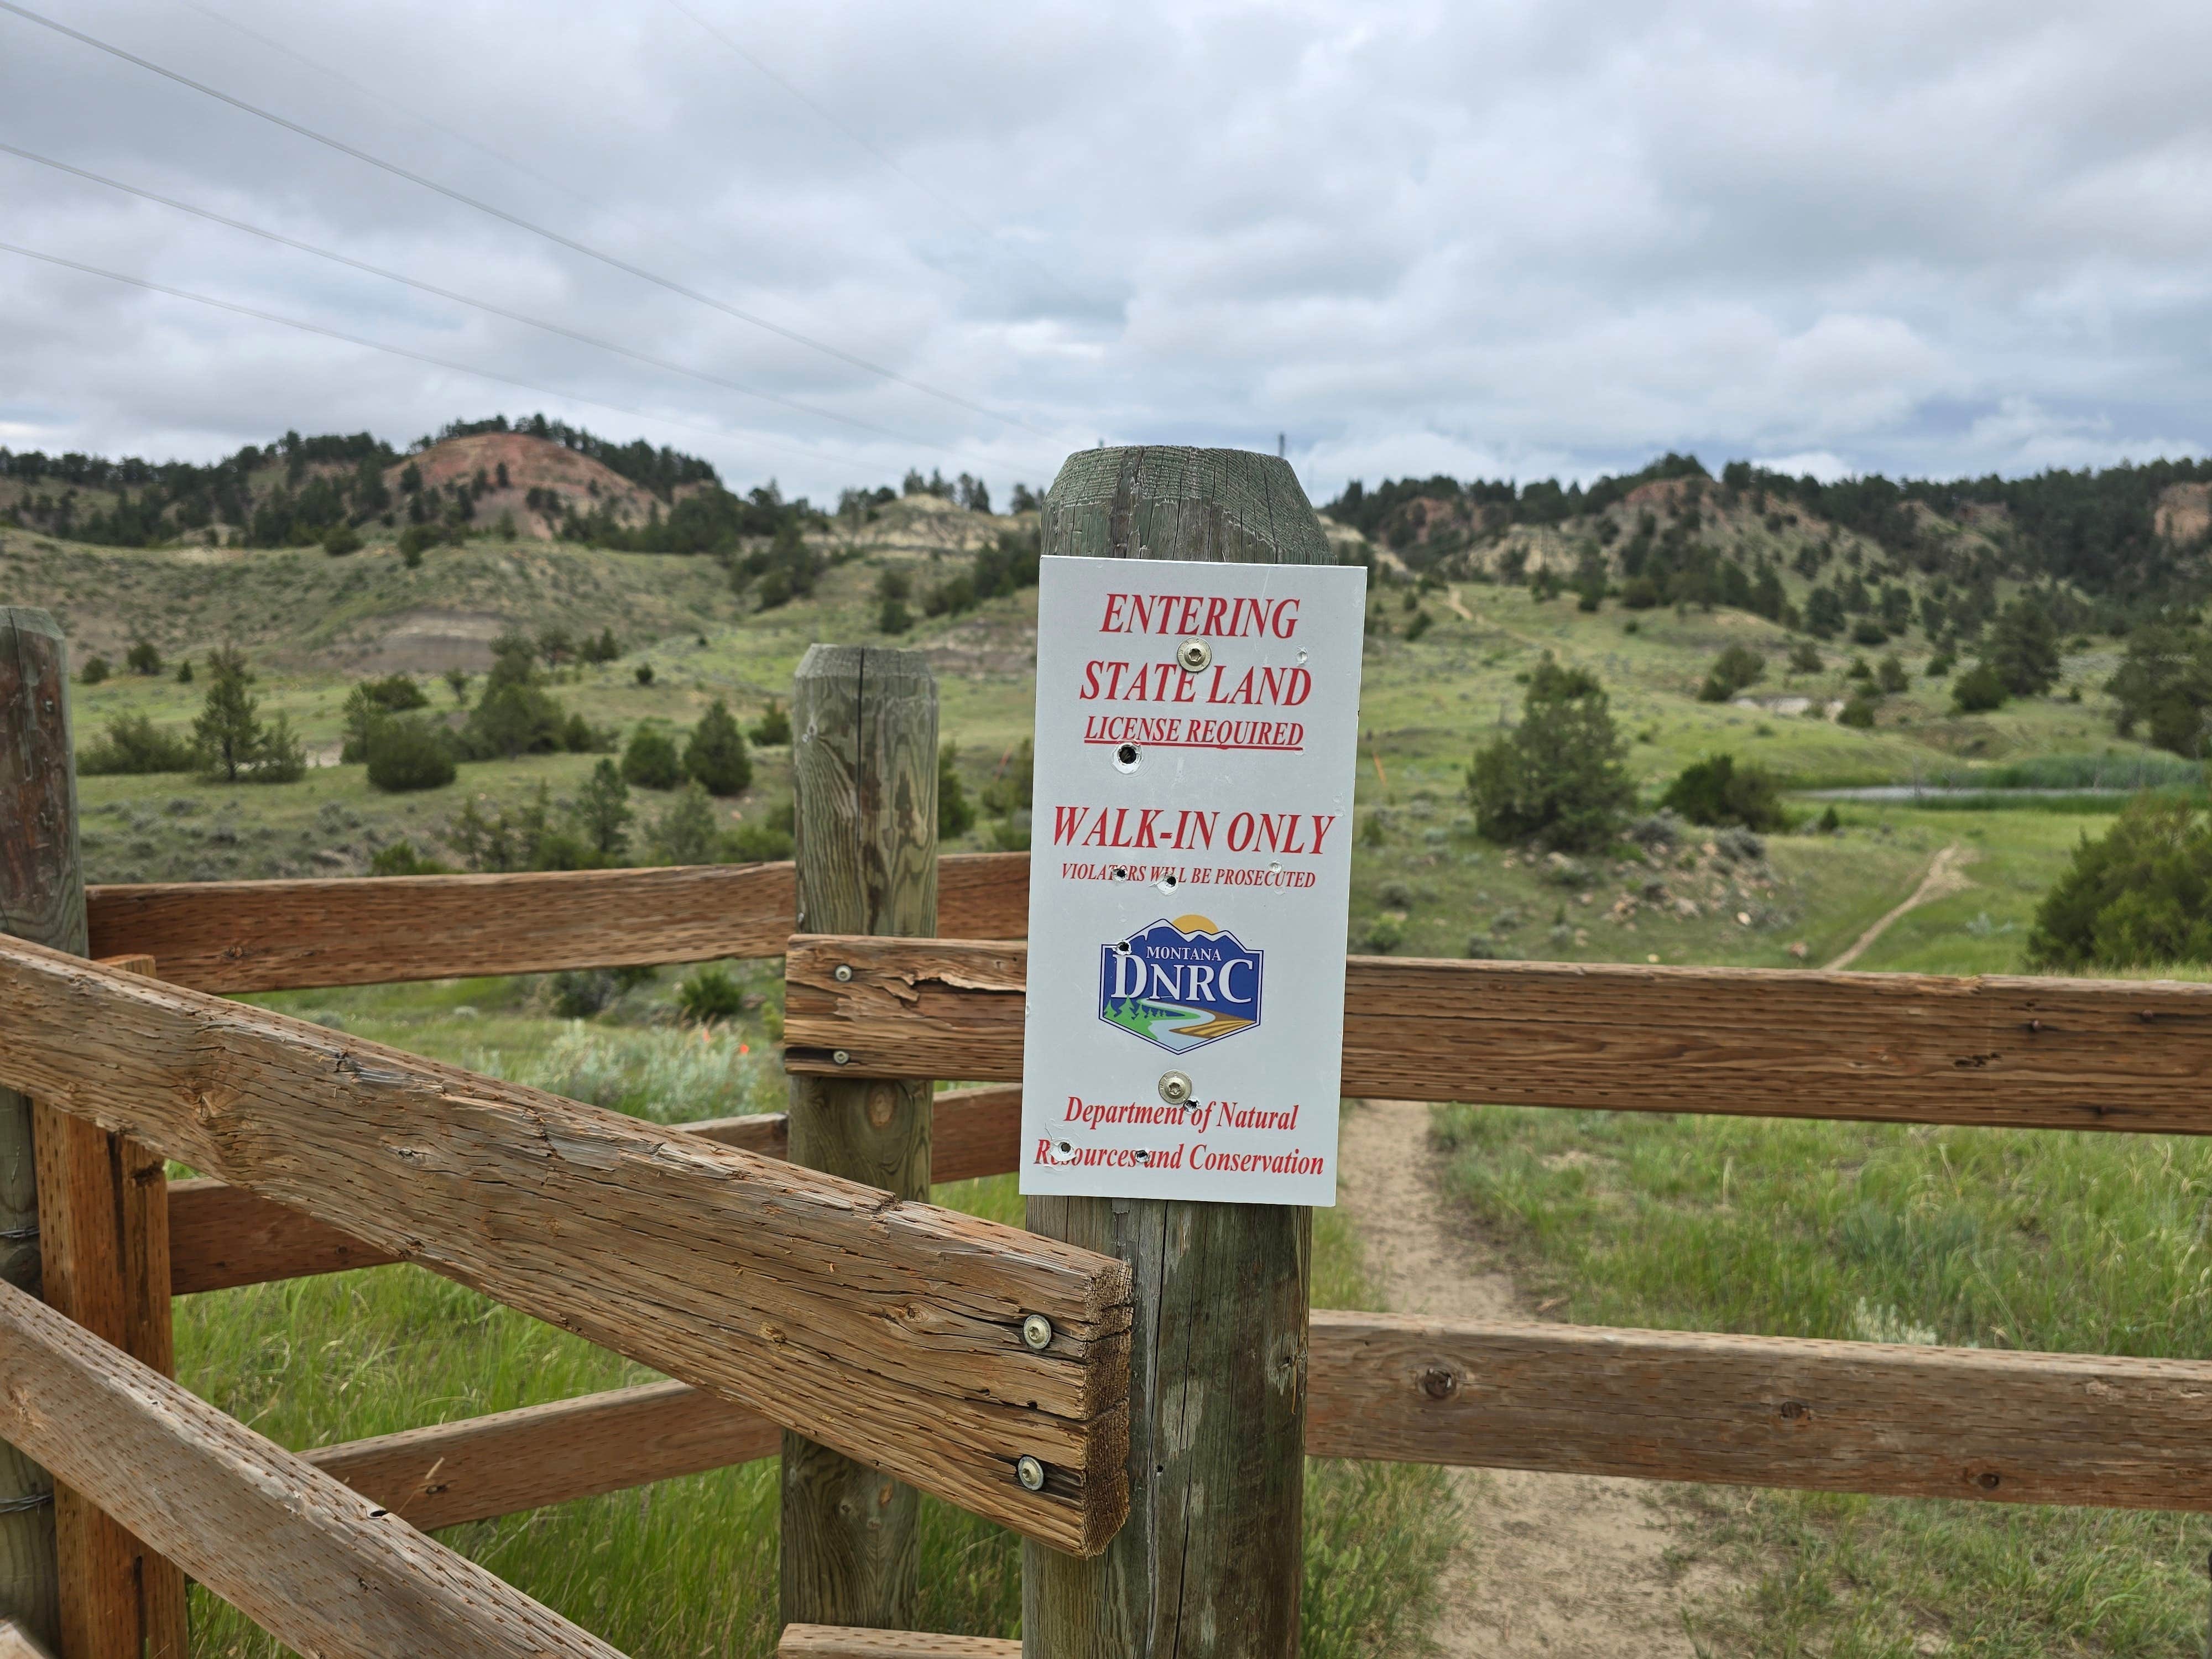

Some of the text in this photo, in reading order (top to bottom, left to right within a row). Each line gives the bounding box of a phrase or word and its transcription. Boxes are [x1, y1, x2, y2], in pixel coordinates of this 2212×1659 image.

[1099, 593, 1300, 639] ENTERING
[1079, 660, 1312, 706] STATE LAND
[1084, 716, 1305, 749] LICENSE REQUIRED
[1053, 806, 1335, 854] WALK-IN ONLY
[1190, 868, 1211, 884] BE
[1214, 869, 1316, 888] PROSECUTED
[1146, 946, 1222, 961] MONTANA
[1110, 954, 1253, 1003] DNRC
[1063, 1096, 1299, 1134] Department of Natural
[1144, 1143, 1184, 1169] and
[1189, 1144, 1324, 1175] Conservation
